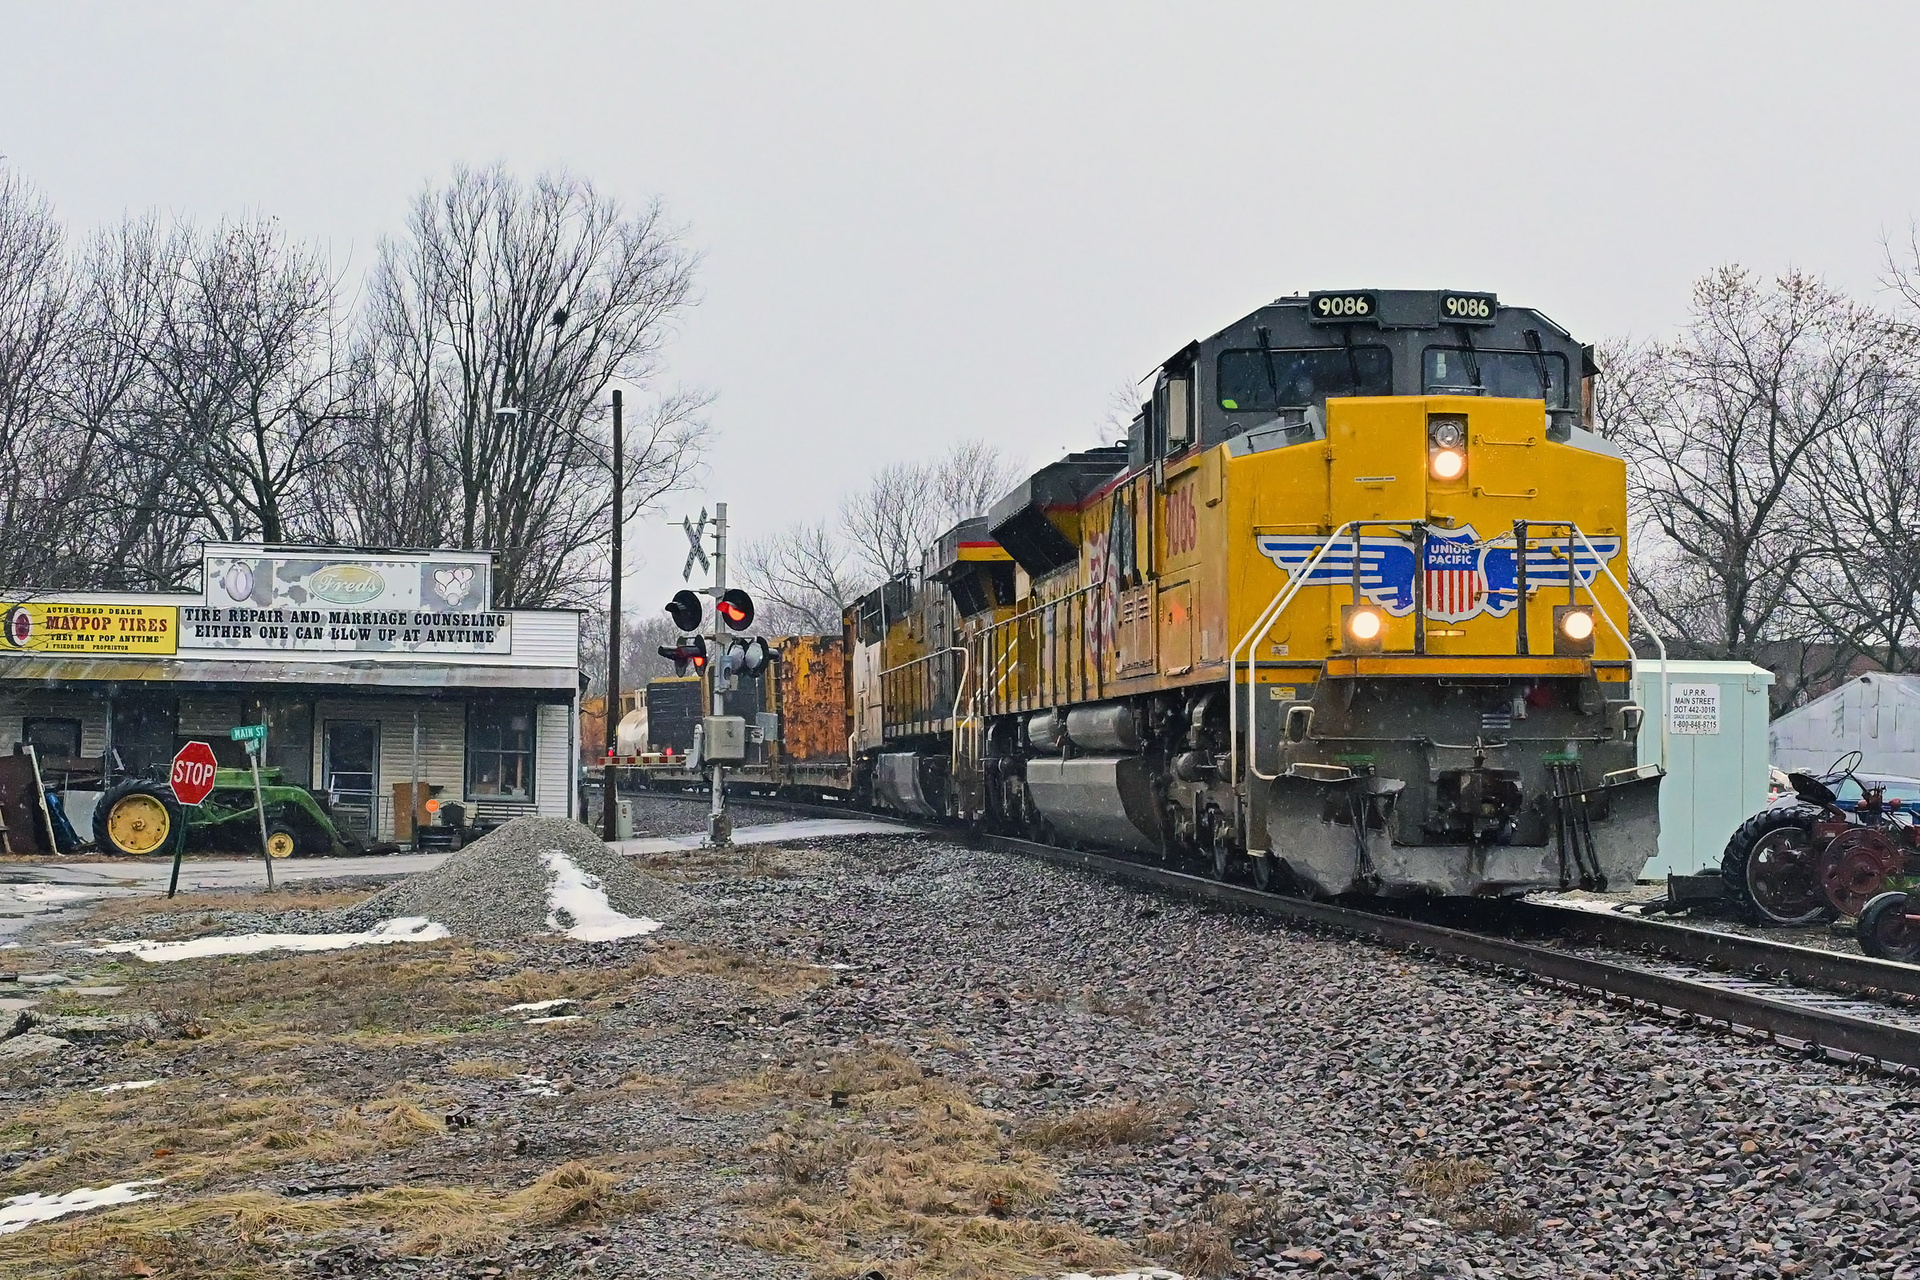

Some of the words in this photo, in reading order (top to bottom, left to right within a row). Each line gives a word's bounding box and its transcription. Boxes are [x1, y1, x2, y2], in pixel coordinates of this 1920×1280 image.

[1318, 297, 1369, 316] 9086
[1446, 297, 1490, 317] 9086
[1431, 544, 1470, 554] UNION
[1428, 555, 1472, 565] PACIFIC
[46, 607, 104, 615] AUTHORIZED
[108, 608, 143, 616] DEALER
[185, 609, 221, 622] TIRE
[228, 609, 284, 623] REPAIR
[290, 610, 321, 624] AND
[328, 611, 407, 625] MARRIAGE
[414, 613, 506, 627] COUNSELING
[45, 616, 112, 631] MAYPOP
[119, 618, 168, 632] TIRES
[77, 634, 95, 642] MAY
[119, 635, 165, 643] ANYTIME"
[195, 624, 252, 638] EITHER
[259, 626, 289, 639] ONE
[295, 627, 324, 640] CAN
[330, 628, 372, 641] BLOW
[378, 629, 397, 641] UP
[402, 629, 421, 642] AT
[426, 629, 495, 643] ANYTIME
[1674, 697, 1690, 705] MAIN
[1691, 697, 1716, 705] STREET
[1673, 705, 1688, 713] DOT
[1689, 706, 1716, 714] 442-301R
[234, 727, 254, 739] MAIN
[255, 726, 265, 737] ST
[173, 759, 214, 787] STOP
